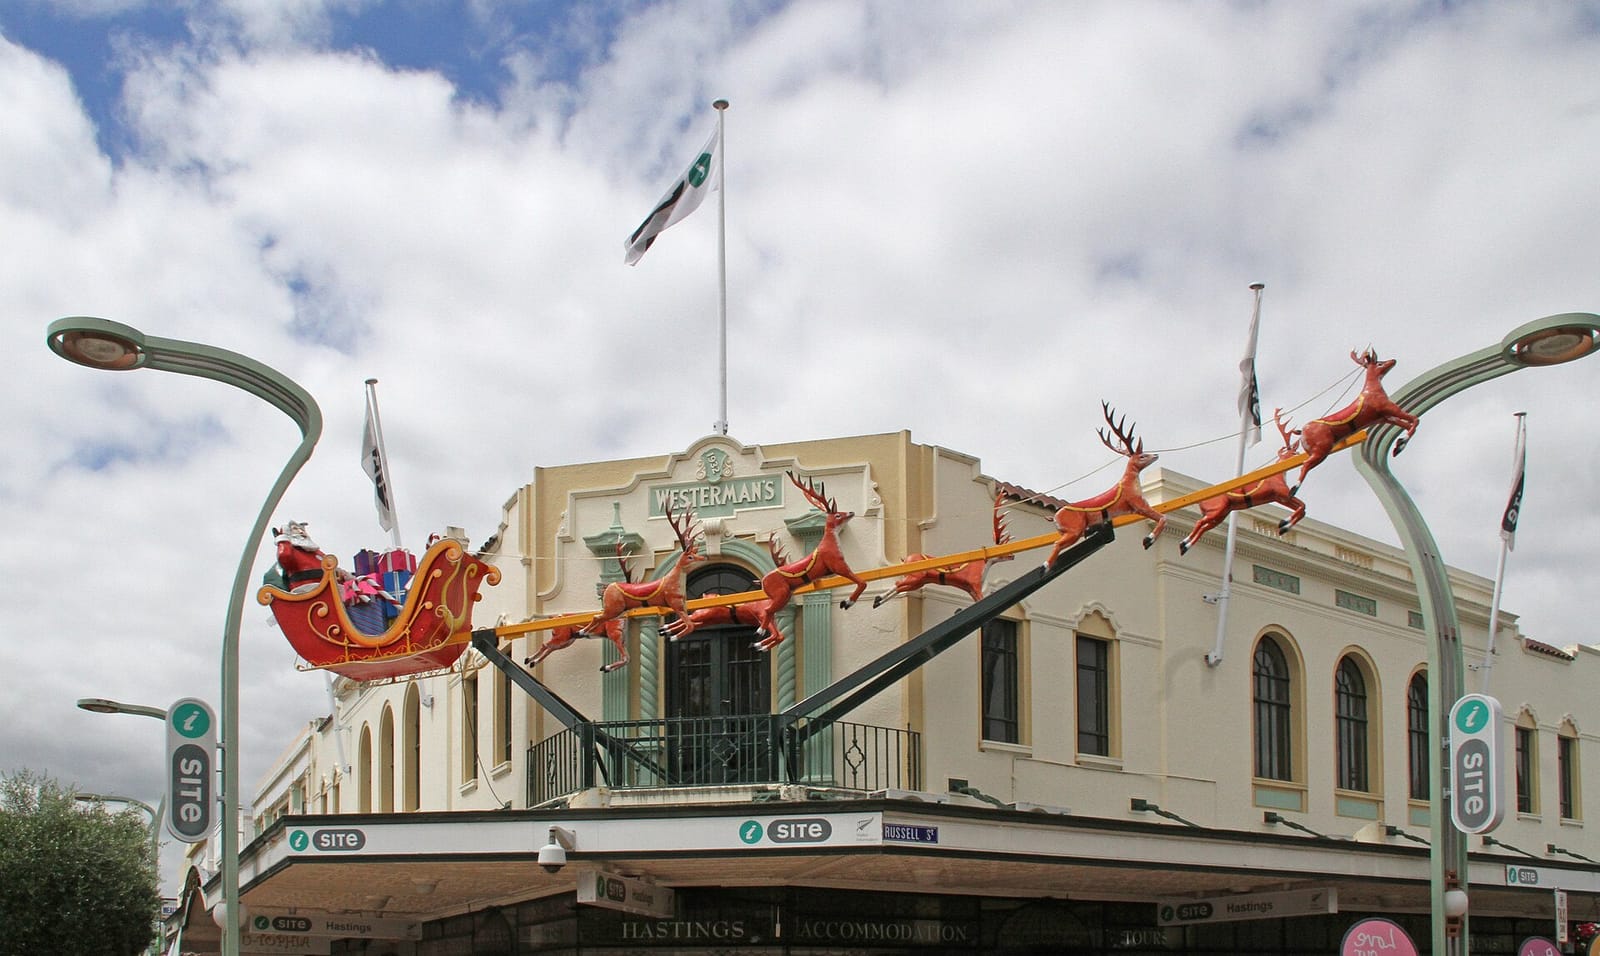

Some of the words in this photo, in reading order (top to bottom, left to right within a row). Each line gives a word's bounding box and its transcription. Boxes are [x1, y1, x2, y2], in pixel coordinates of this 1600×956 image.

[706, 452, 720, 475] 1932
[655, 480, 776, 513] WESTERMAN'S
[885, 826, 920, 841] RUSSELL
[1226, 900, 1274, 914] Hastings
[325, 921, 372, 934] Hastings
[622, 921, 745, 939] HASTINGS
[800, 920, 968, 941] ACCOMMODATION
